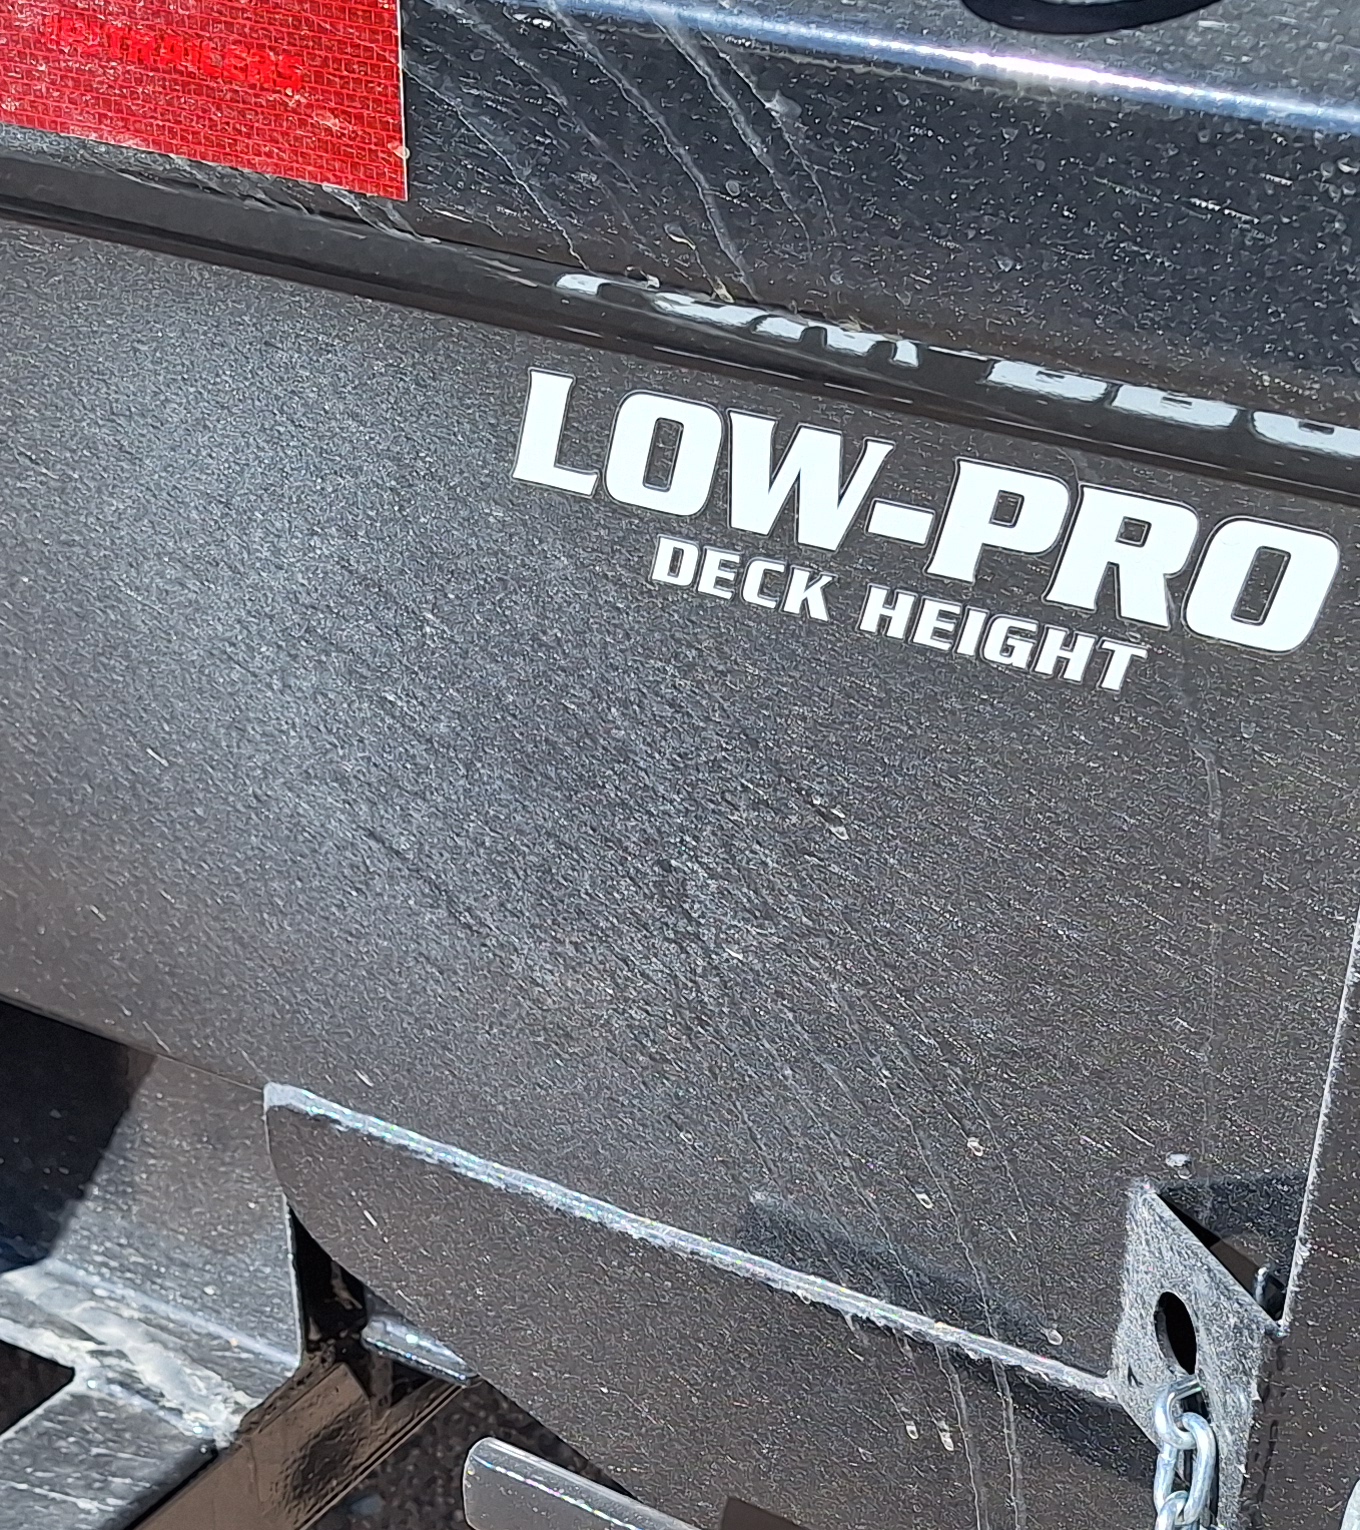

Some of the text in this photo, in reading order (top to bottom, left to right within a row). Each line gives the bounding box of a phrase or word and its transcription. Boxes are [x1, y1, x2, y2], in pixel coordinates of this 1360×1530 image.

[105, 21, 304, 90] TRAILERS
[510, 368, 1343, 655] LOW-PRO
[650, 535, 1149, 693] DECK HEIGHT
